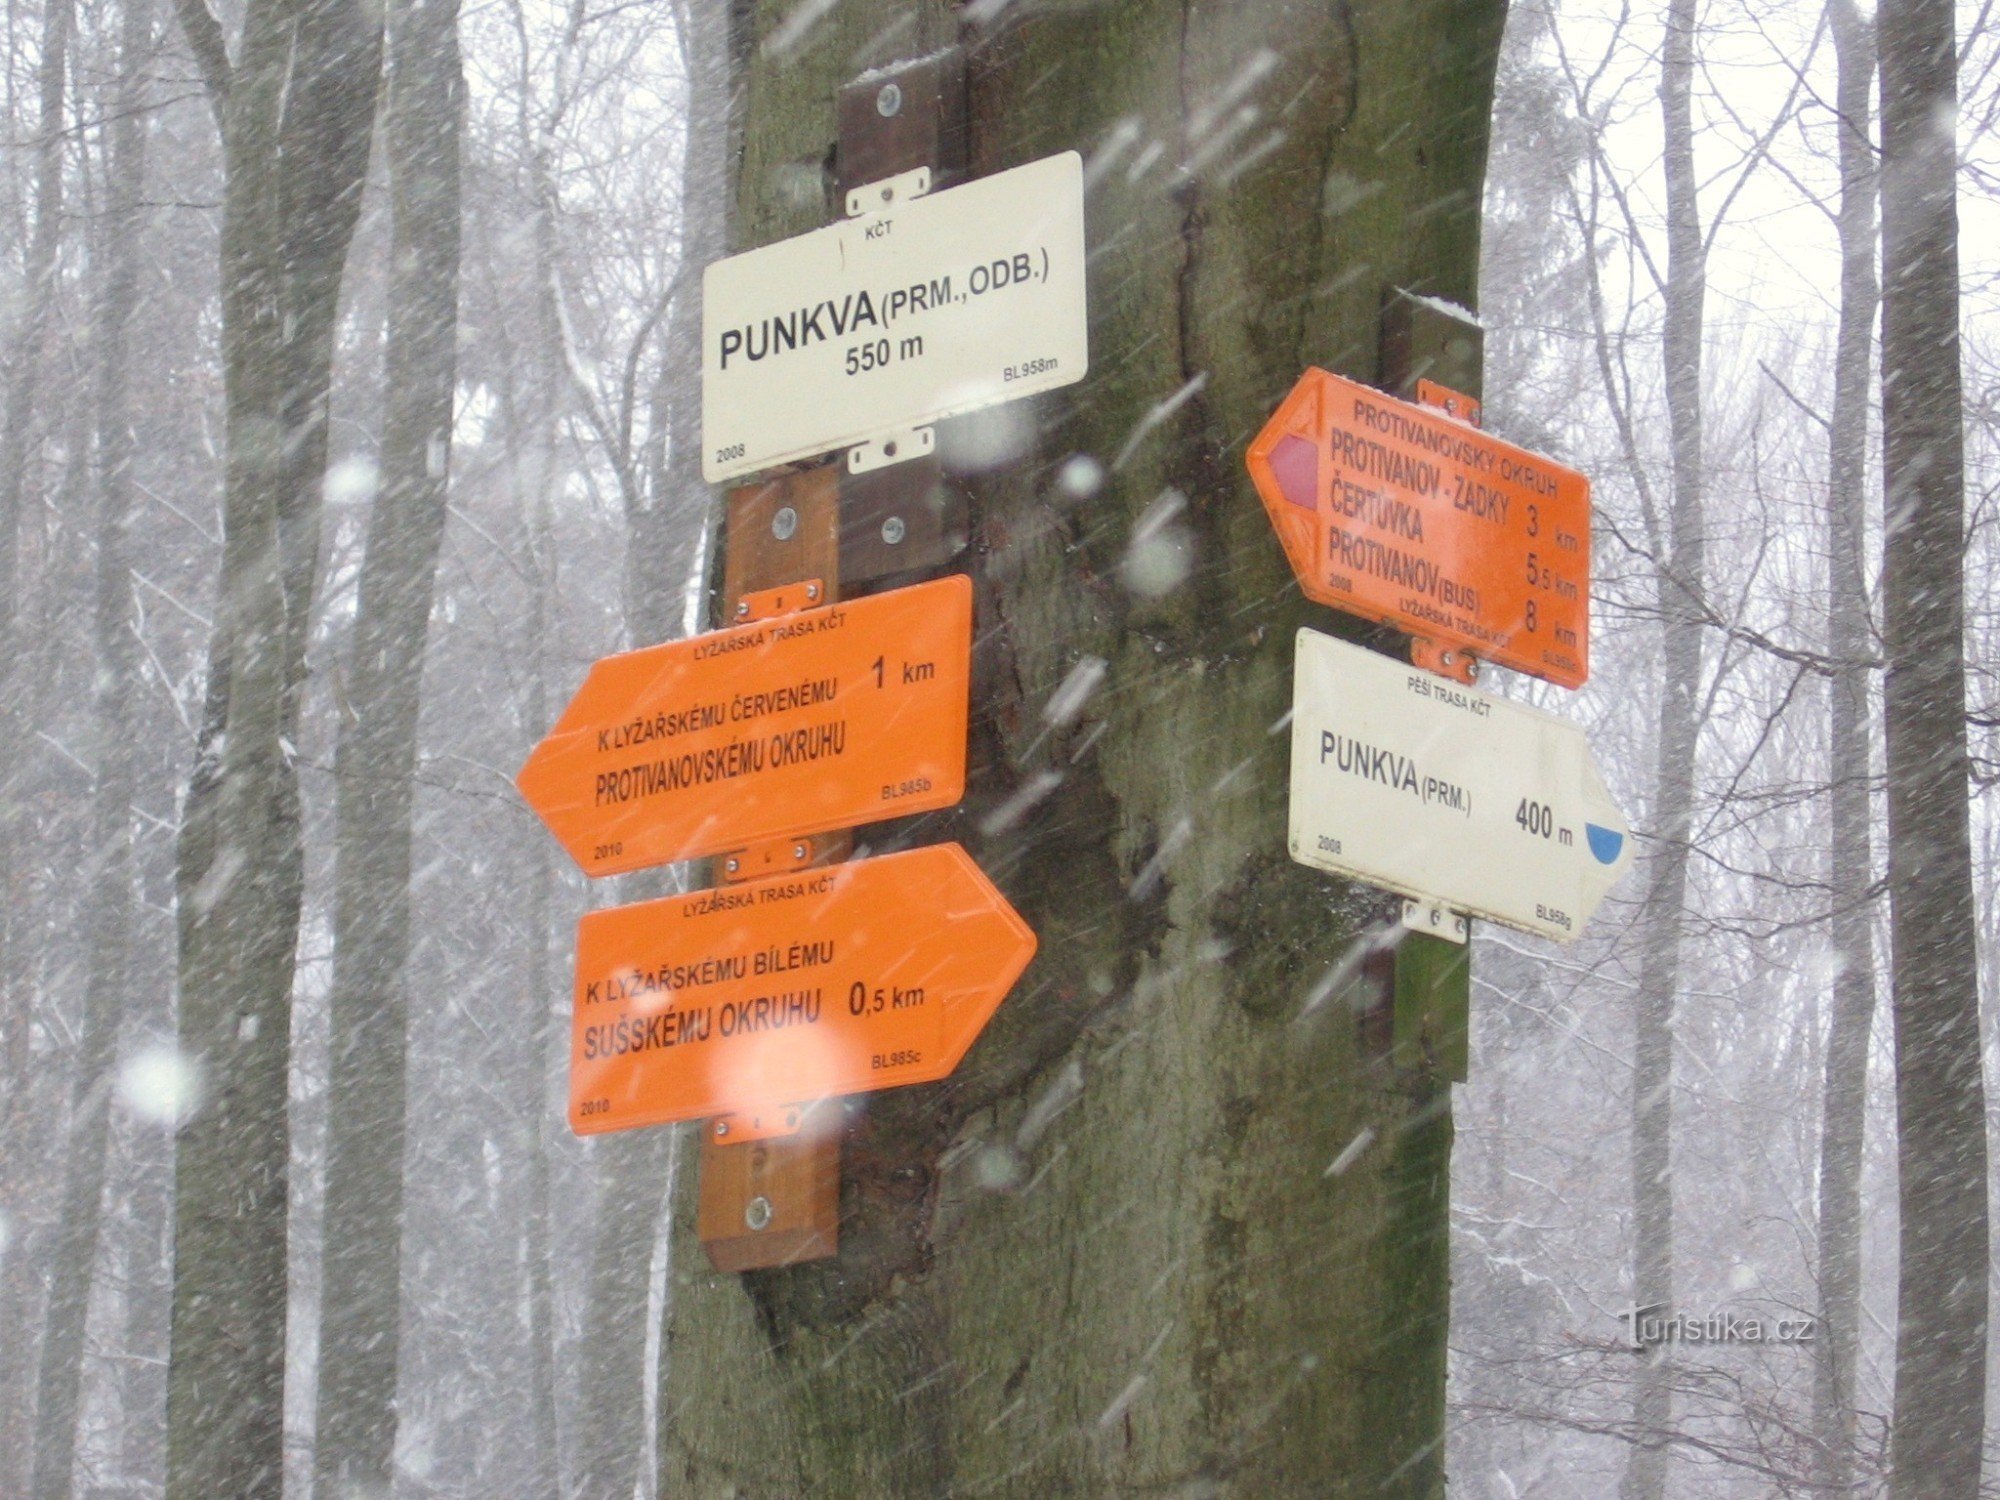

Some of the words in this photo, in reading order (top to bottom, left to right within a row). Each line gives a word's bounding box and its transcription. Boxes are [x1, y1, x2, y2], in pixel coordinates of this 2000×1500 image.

[865, 220, 893, 240] KČT
[846, 338, 890, 375] 550
[900, 334, 923, 360] m
[1003, 357, 1058, 382] BL958m
[716, 443, 745, 463] 2008
[1501, 457, 1559, 499] OKRUH
[1527, 505, 1539, 538] 3
[1555, 527, 1578, 552] km
[1555, 573, 1578, 600] km
[769, 622, 814, 642] TRASA
[1526, 600, 1537, 632] 8
[1555, 621, 1577, 649] km
[598, 730, 610, 752] K
[614, 703, 726, 749] LYŽAŘSKÉMU
[730, 677, 838, 722] ČERVENÉMU
[871, 655, 884, 689] 1
[902, 660, 936, 685] km
[1434, 685, 1468, 711] TRASA
[595, 736, 765, 807] PROTIVANOVSKÉMU
[770, 721, 846, 769] OKRUHU
[1515, 797, 1552, 839] 400
[1558, 826, 1573, 847] m
[758, 884, 804, 904] TRASA
[586, 983, 599, 1005] K
[605, 954, 746, 1003] LYŽAŘSKÉMU
[754, 941, 834, 973] BÍLÉMU
[584, 1007, 711, 1060] SUŠSKÉMU
[720, 988, 821, 1037] OKRUHU
[848, 981, 885, 1020] 0,5
[893, 986, 925, 1009] km
